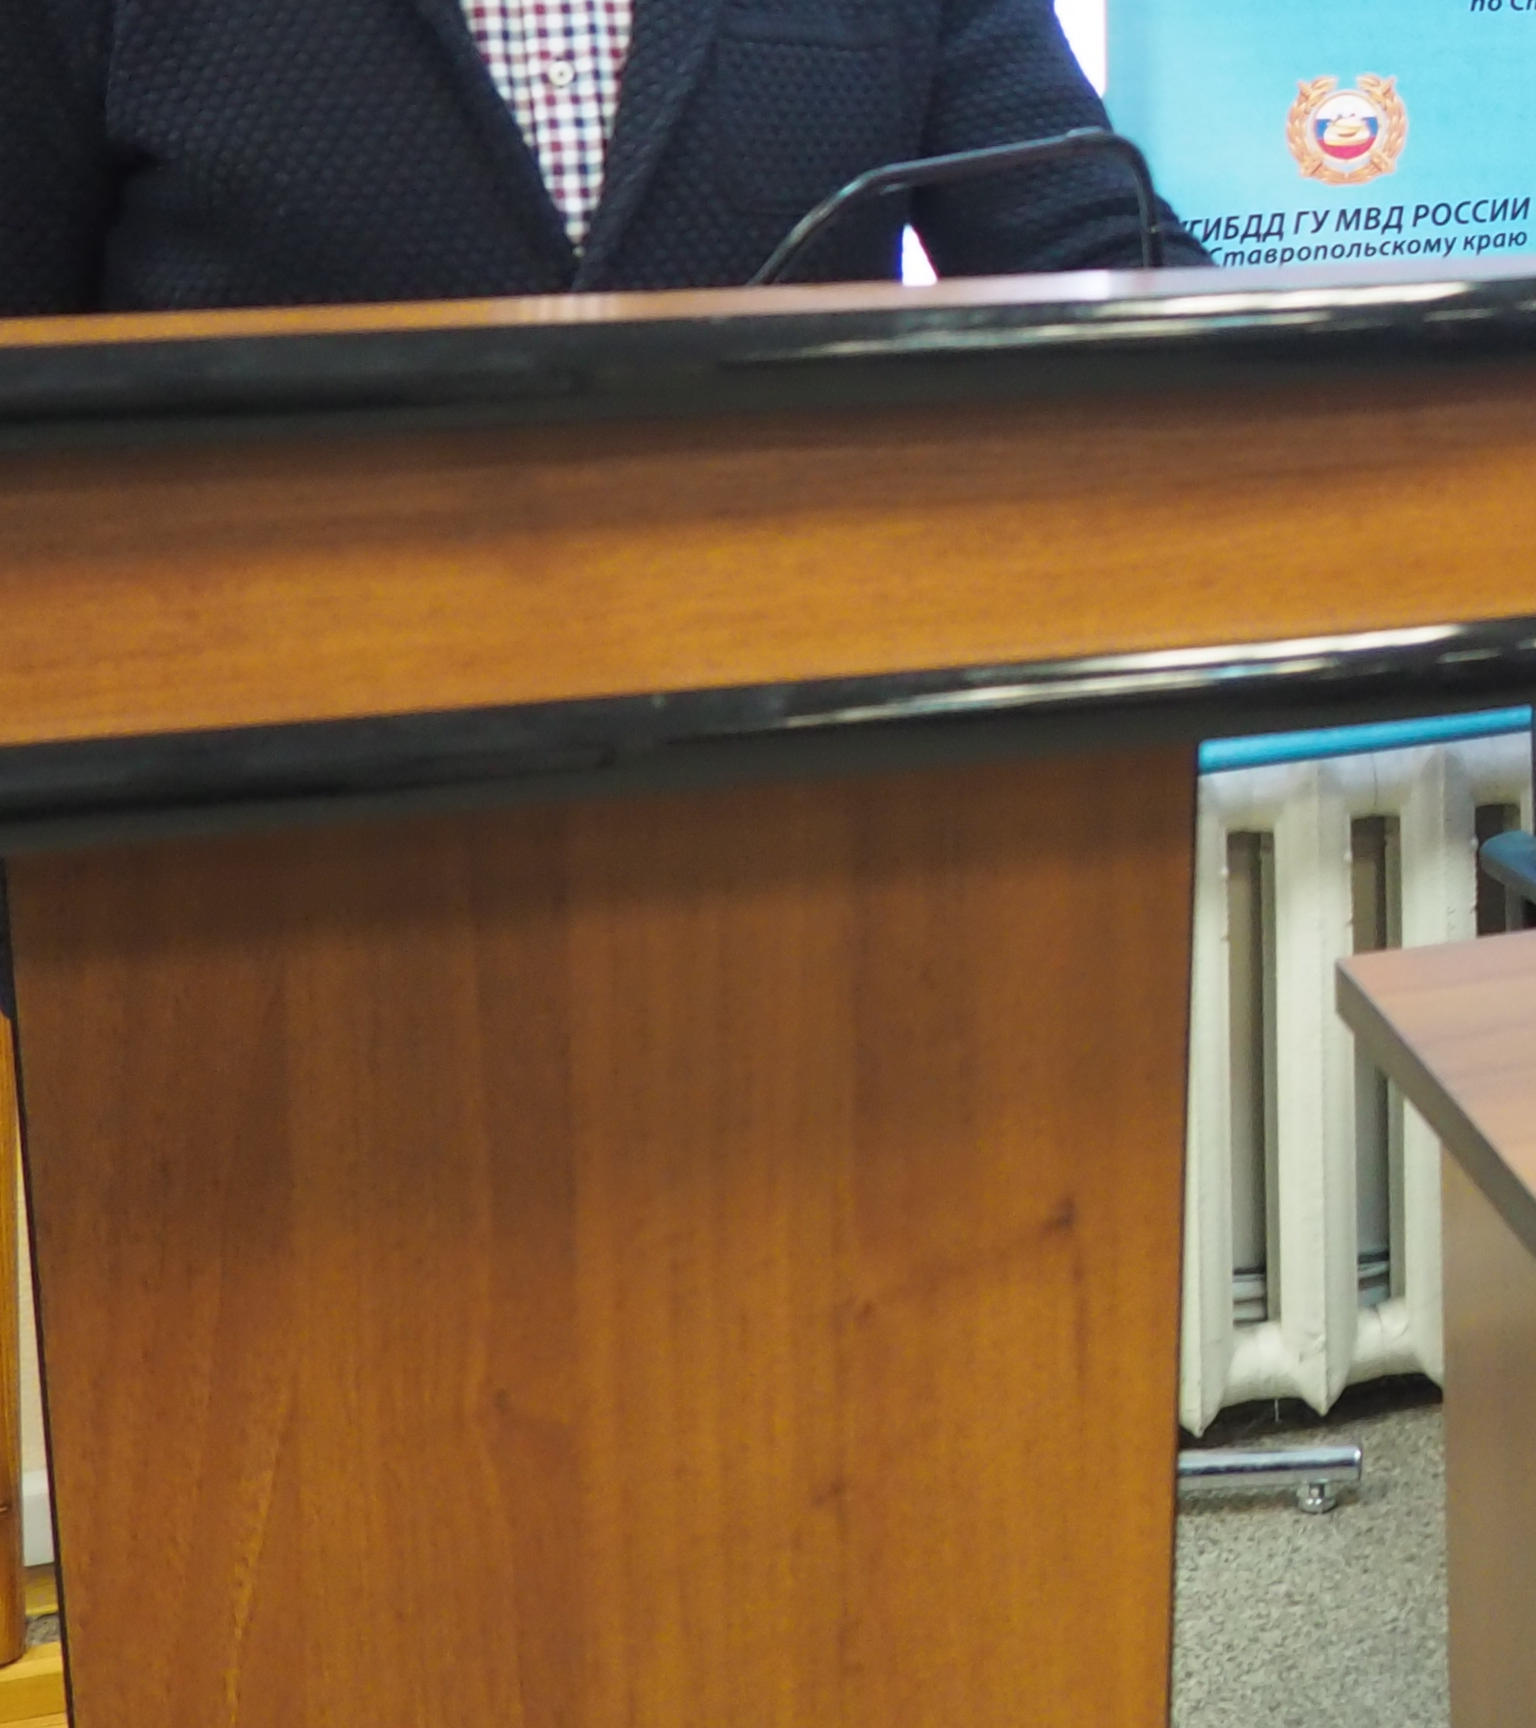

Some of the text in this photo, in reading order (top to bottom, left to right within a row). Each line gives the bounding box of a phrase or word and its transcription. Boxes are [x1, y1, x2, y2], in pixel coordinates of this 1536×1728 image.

[1293, 210, 1329, 235] ГУ
[1335, 205, 1405, 236] МВД
[1412, 197, 1531, 227] РОССИИ
[1462, 232, 1528, 255] краю
